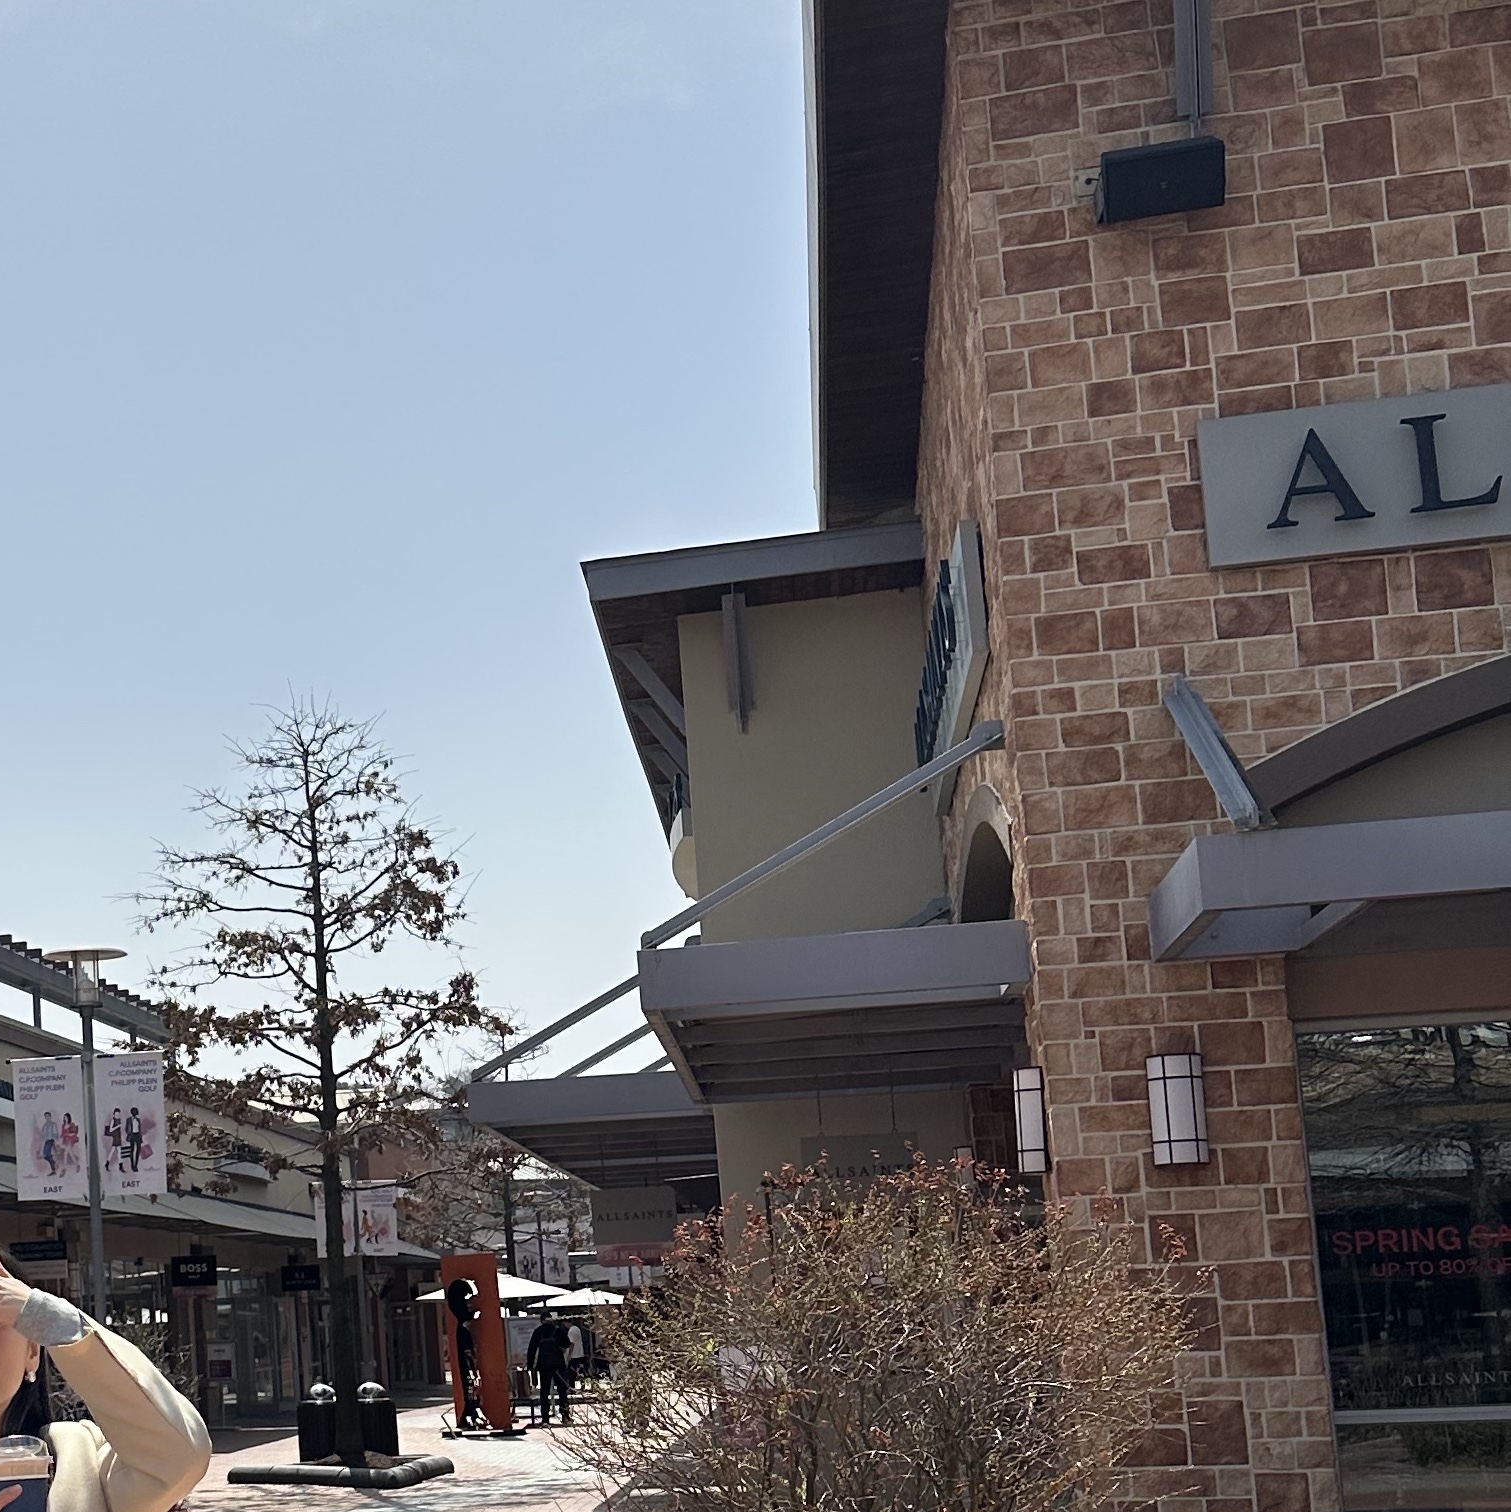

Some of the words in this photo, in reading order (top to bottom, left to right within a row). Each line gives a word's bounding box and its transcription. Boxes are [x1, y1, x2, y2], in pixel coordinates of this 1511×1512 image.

[1267, 413, 1503, 530] AL
[43, 1186, 63, 1194] EAST
[122, 1180, 141, 1189] EAST
[597, 1209, 674, 1222] ALLSAINTS
[1331, 1225, 1462, 1256] SPRING
[179, 1263, 208, 1273] BOSS
[1372, 1262, 1400, 1277] UP
[1405, 1260, 1434, 1276] TO
[1439, 1258, 1485, 1275] 80%
